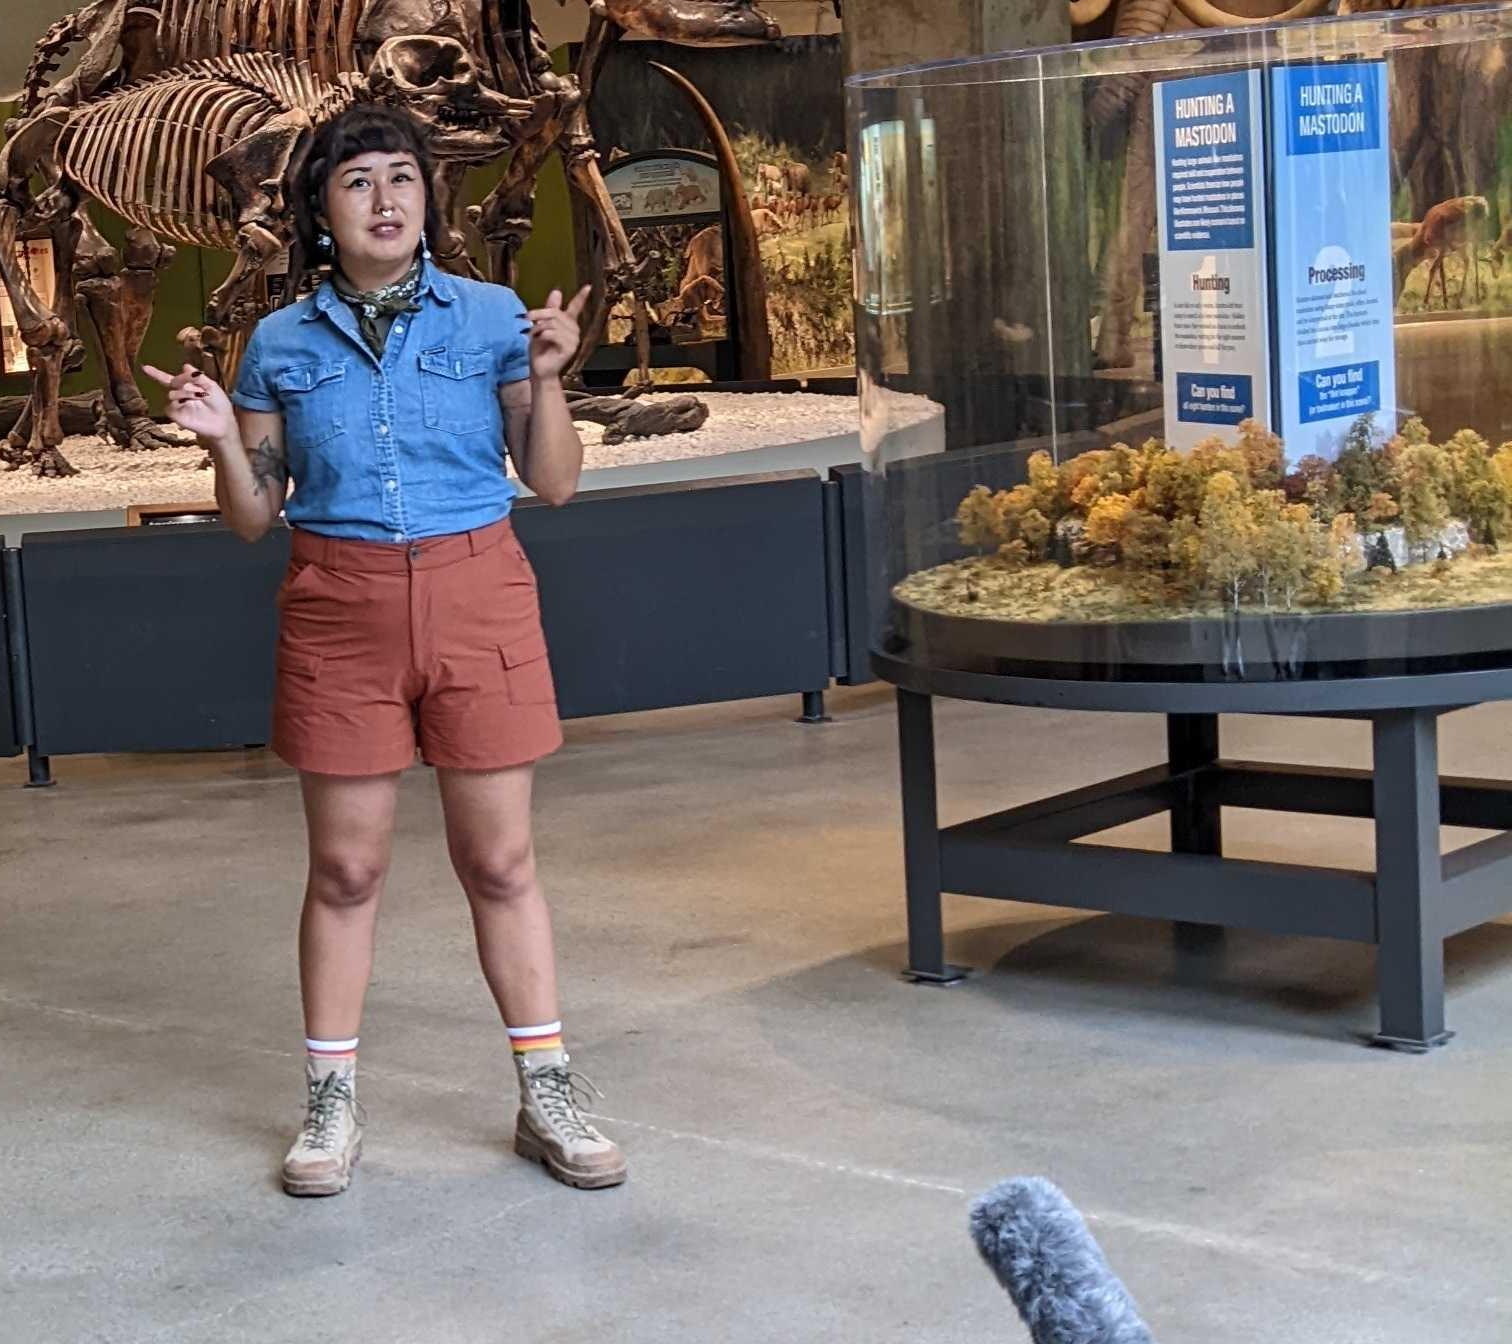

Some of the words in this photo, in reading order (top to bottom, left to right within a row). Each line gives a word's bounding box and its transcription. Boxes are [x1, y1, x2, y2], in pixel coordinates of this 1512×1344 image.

[1176, 95, 1224, 119] HUNTING
[1225, 93, 1235, 113] A
[1301, 85, 1352, 106] HUNTING
[1354, 83, 1364, 103] A
[1176, 123, 1236, 148] MASTODON
[1300, 113, 1364, 136] MASTODON
[1192, 273, 1230, 294] Hunting
[1308, 262, 1365, 285] Processing
[1315, 374, 1331, 389] Can
[1332, 373, 1346, 388] you
[1347, 368, 1364, 383] find
[1191, 383, 1205, 398] Can
[1206, 387, 1219, 401] you
[1220, 384, 1236, 400] find
